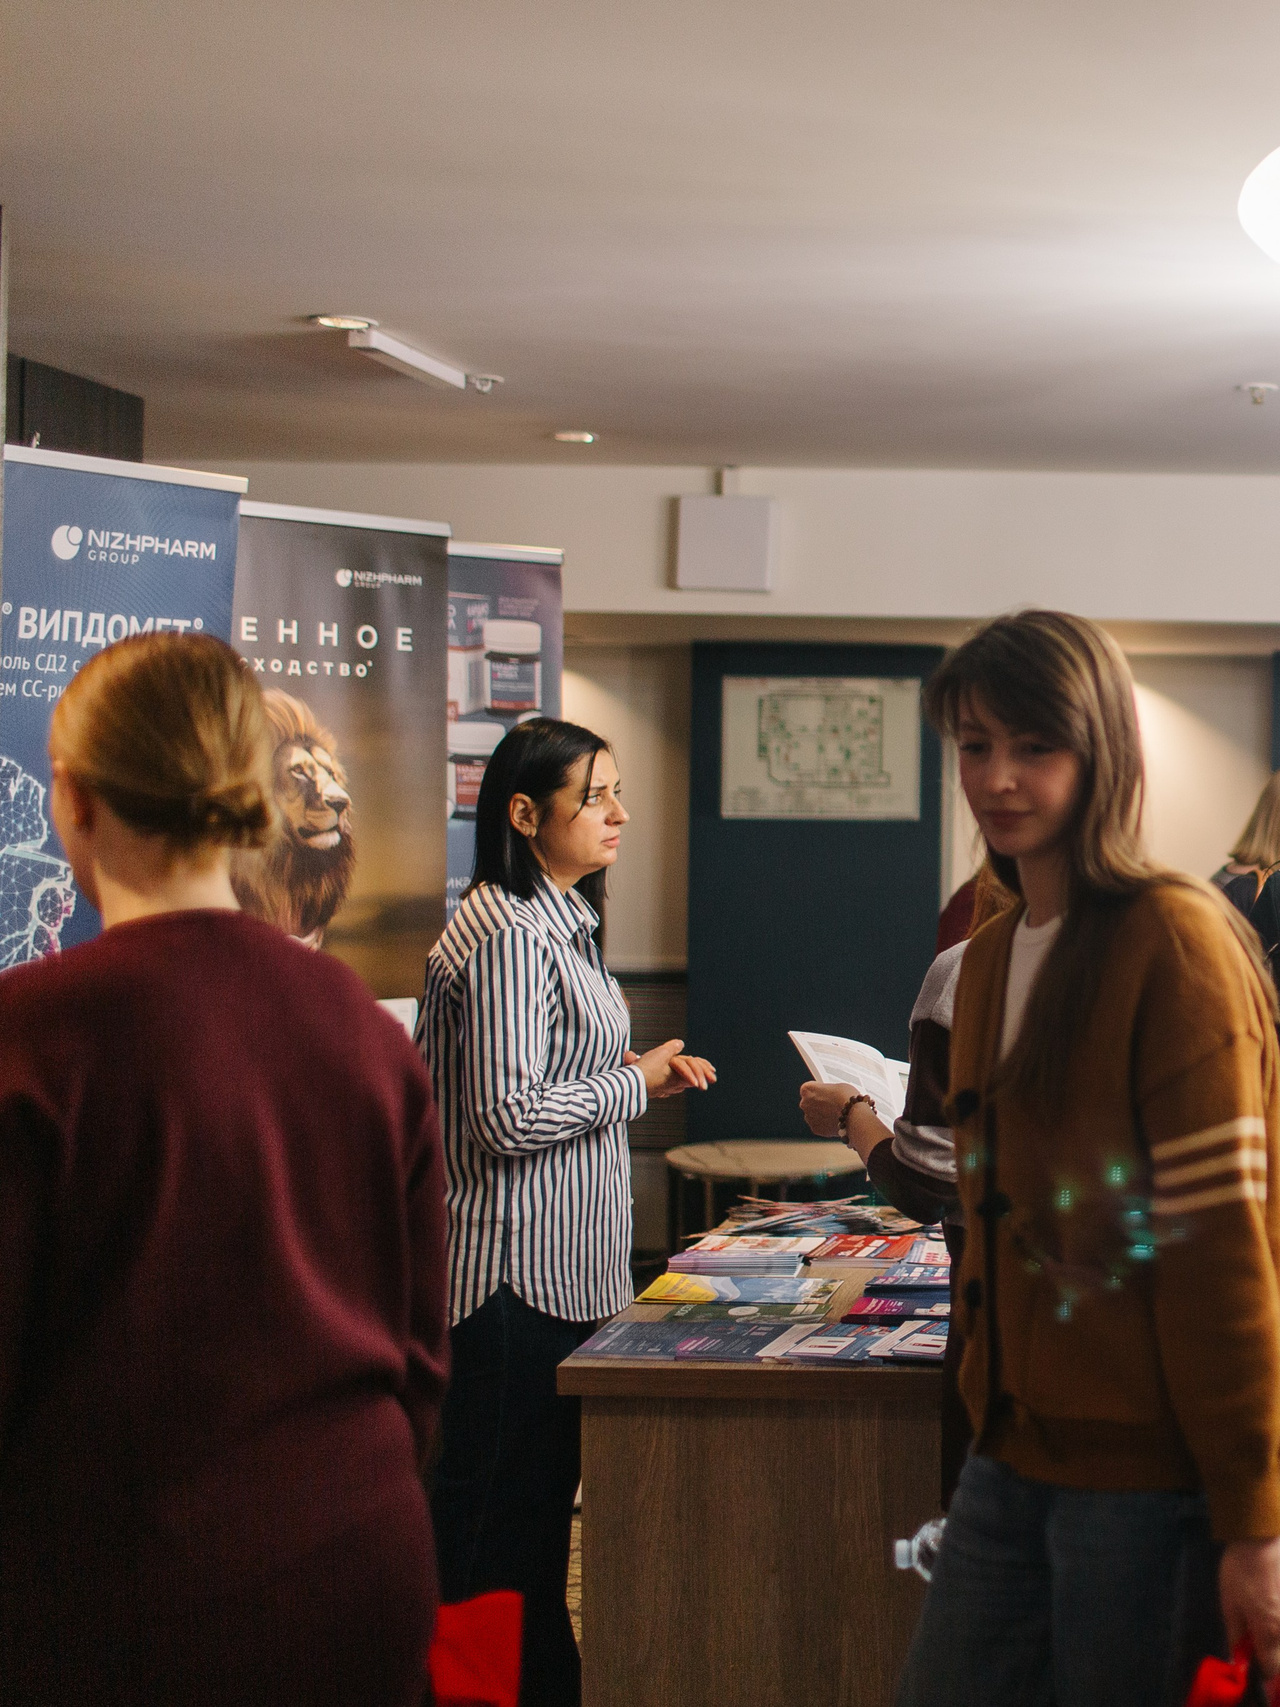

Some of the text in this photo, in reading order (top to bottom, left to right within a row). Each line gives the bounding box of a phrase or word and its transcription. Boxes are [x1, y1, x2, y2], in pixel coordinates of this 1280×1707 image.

[87, 529, 216, 560] NIZHPHARM
[88, 550, 139, 564] GROUP
[353, 570, 423, 586] NIZHPHARM
[0, 655, 31, 670] оль
[35, 653, 67, 674] СД2
